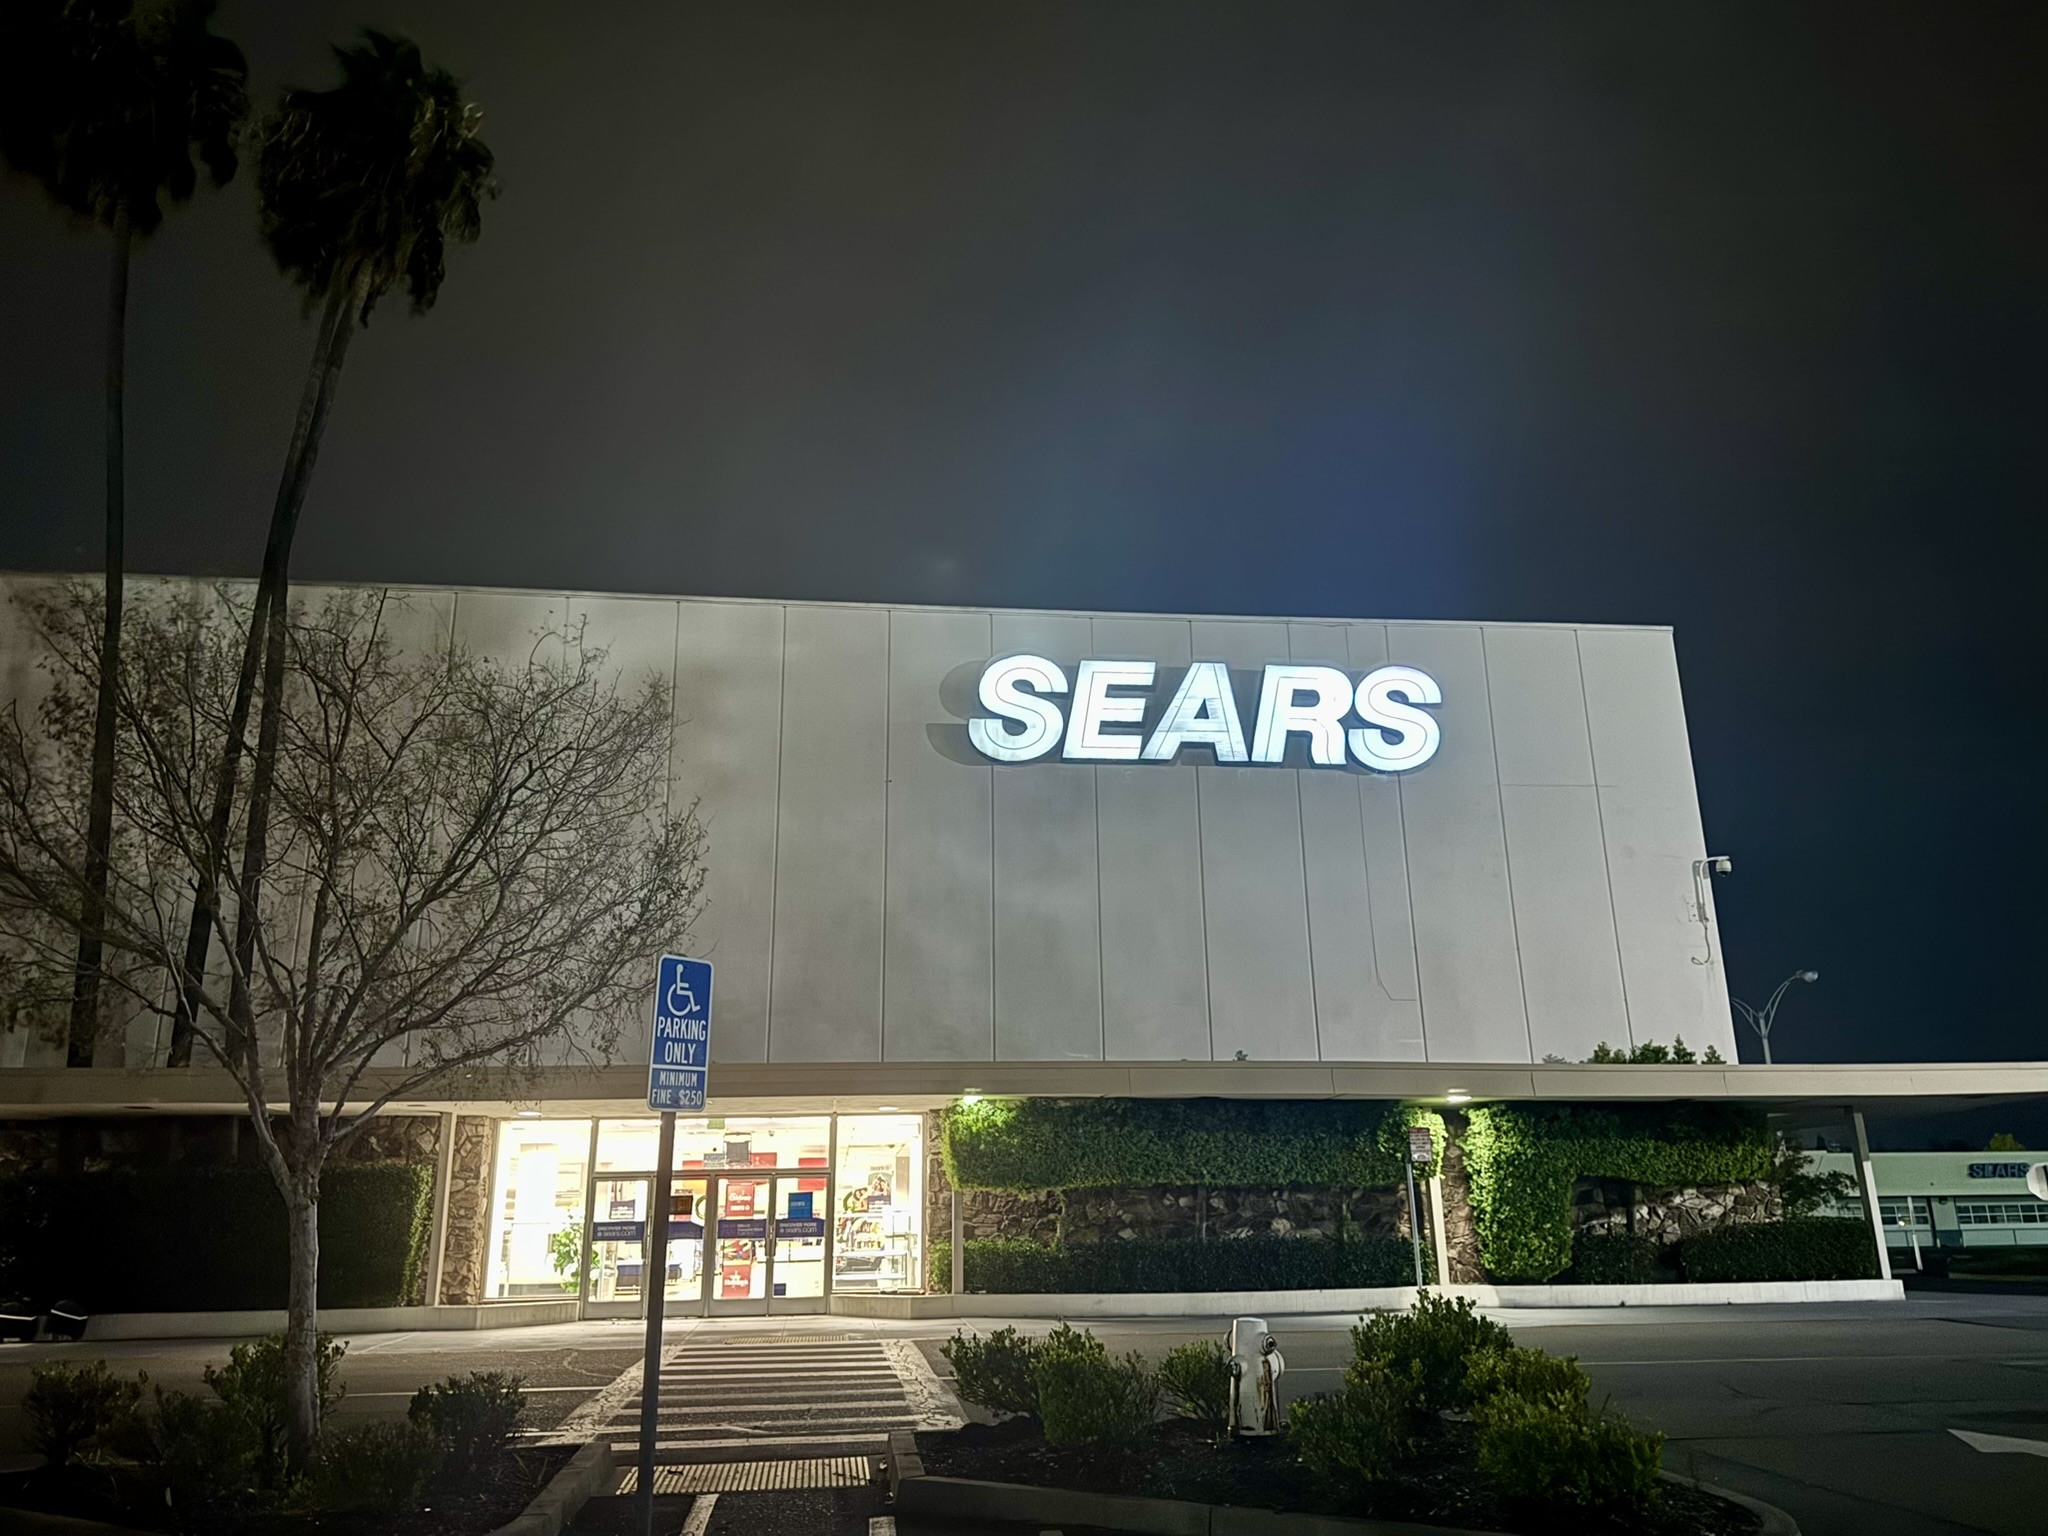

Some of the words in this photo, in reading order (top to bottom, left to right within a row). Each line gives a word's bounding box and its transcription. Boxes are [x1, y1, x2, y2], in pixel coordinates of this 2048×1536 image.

[967, 654, 1443, 773] SEARS
[657, 1016, 707, 1041] PARKING
[664, 1041, 696, 1064] ONLY
[659, 1071, 698, 1087] MINIMUM
[651, 1088, 672, 1104] FINE
[678, 1089, 702, 1105] $250
[1969, 1163, 2029, 1178] SEARS
